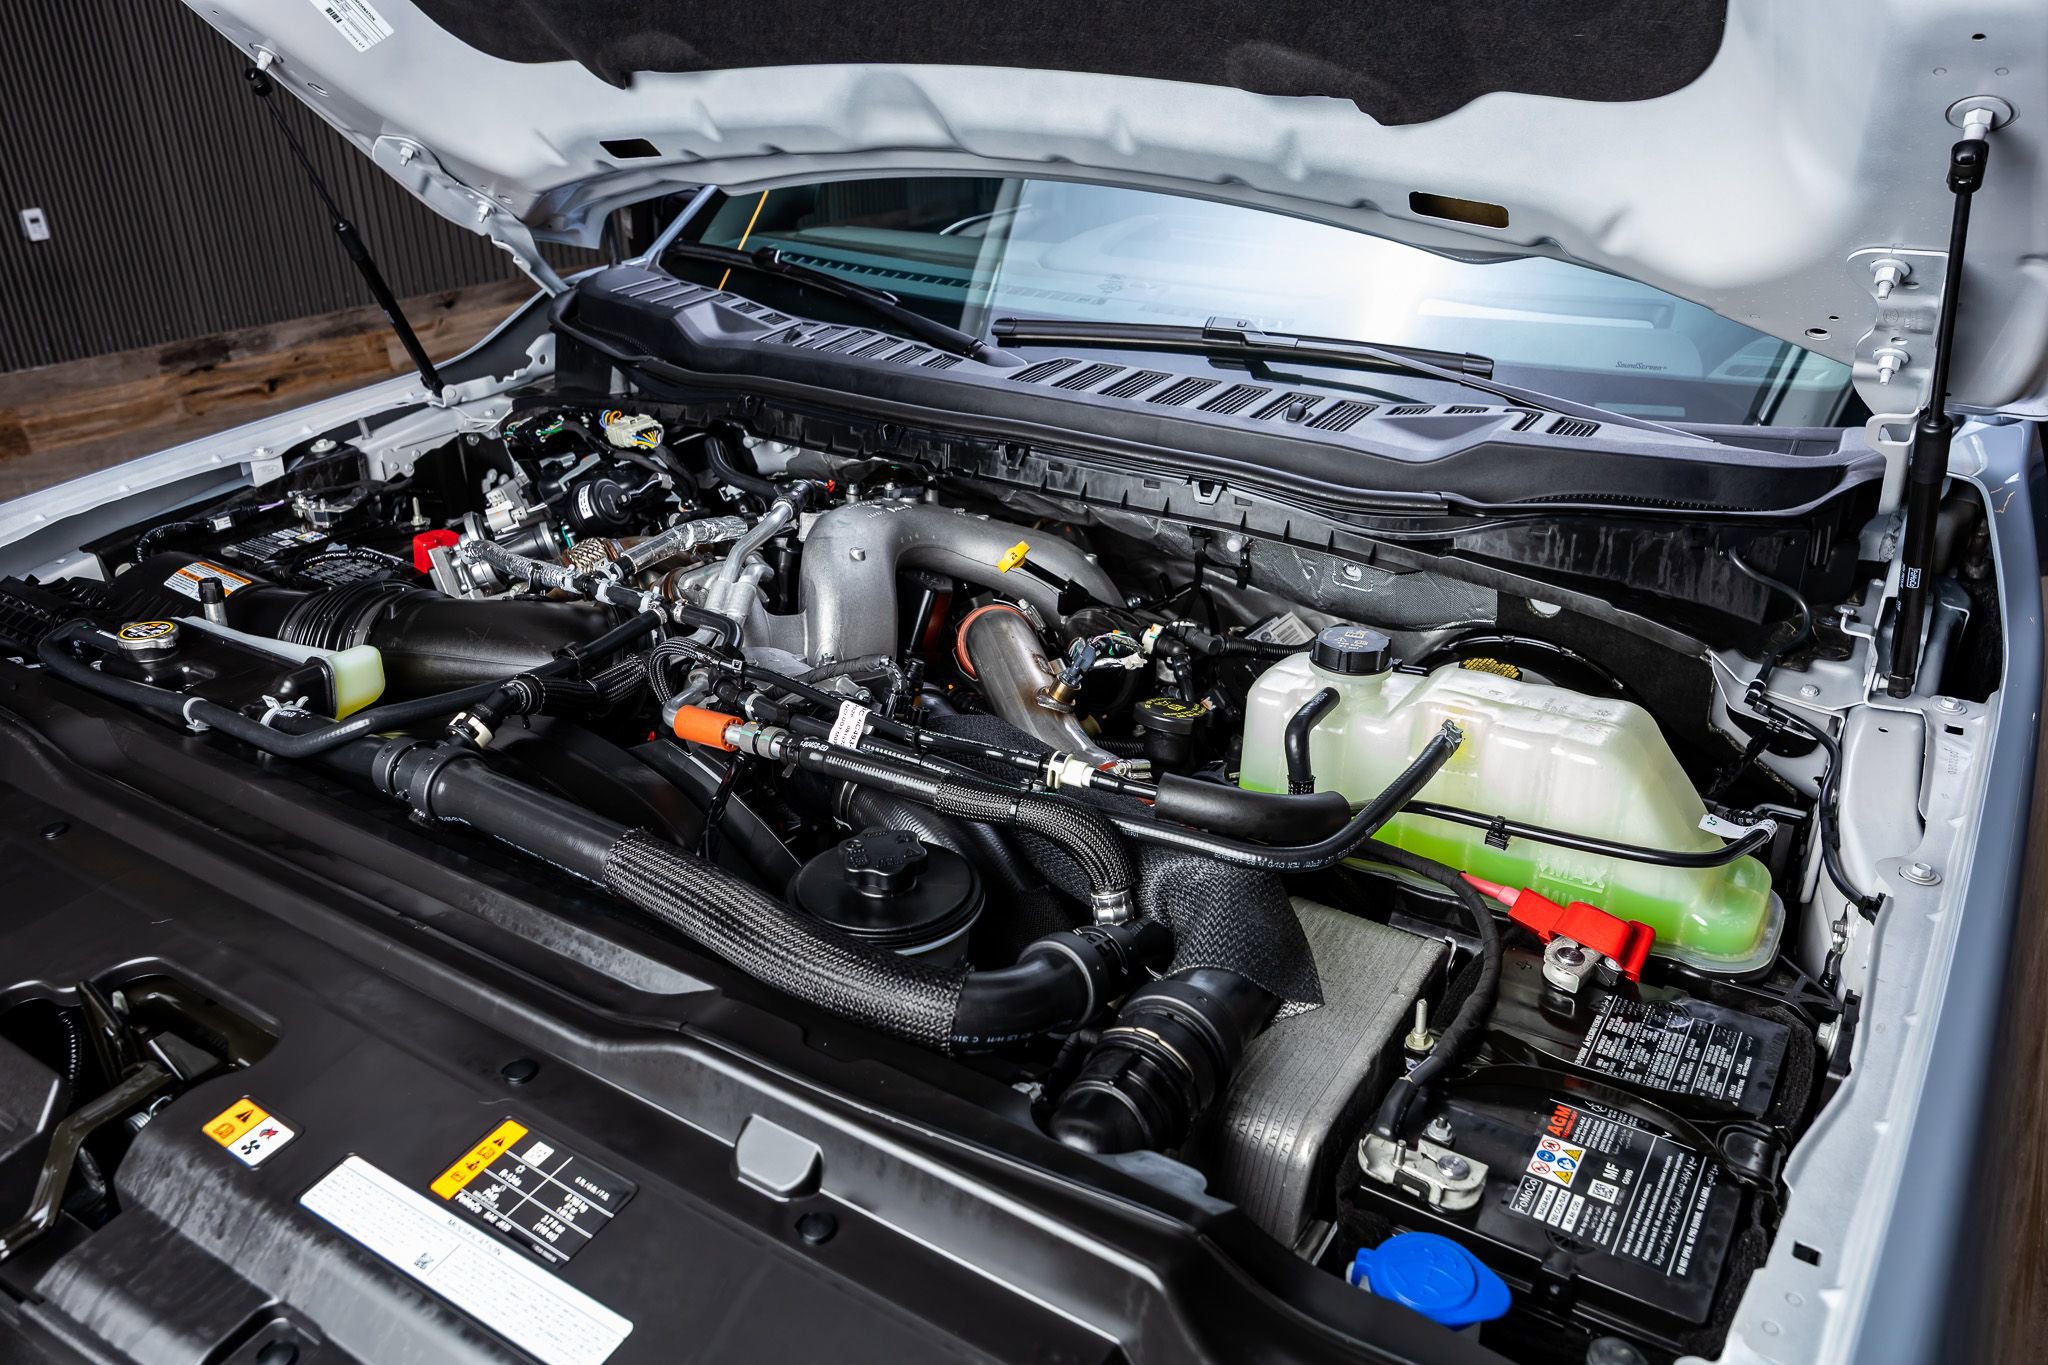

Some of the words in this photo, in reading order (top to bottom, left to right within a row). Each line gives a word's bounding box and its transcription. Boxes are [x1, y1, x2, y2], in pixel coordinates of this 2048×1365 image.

[1546, 1104, 1572, 1136] AGM
[1601, 1161, 1621, 1181] MF
[1515, 1178, 1539, 1214] FoMoCo
[1677, 1256, 1690, 1269] NOT
